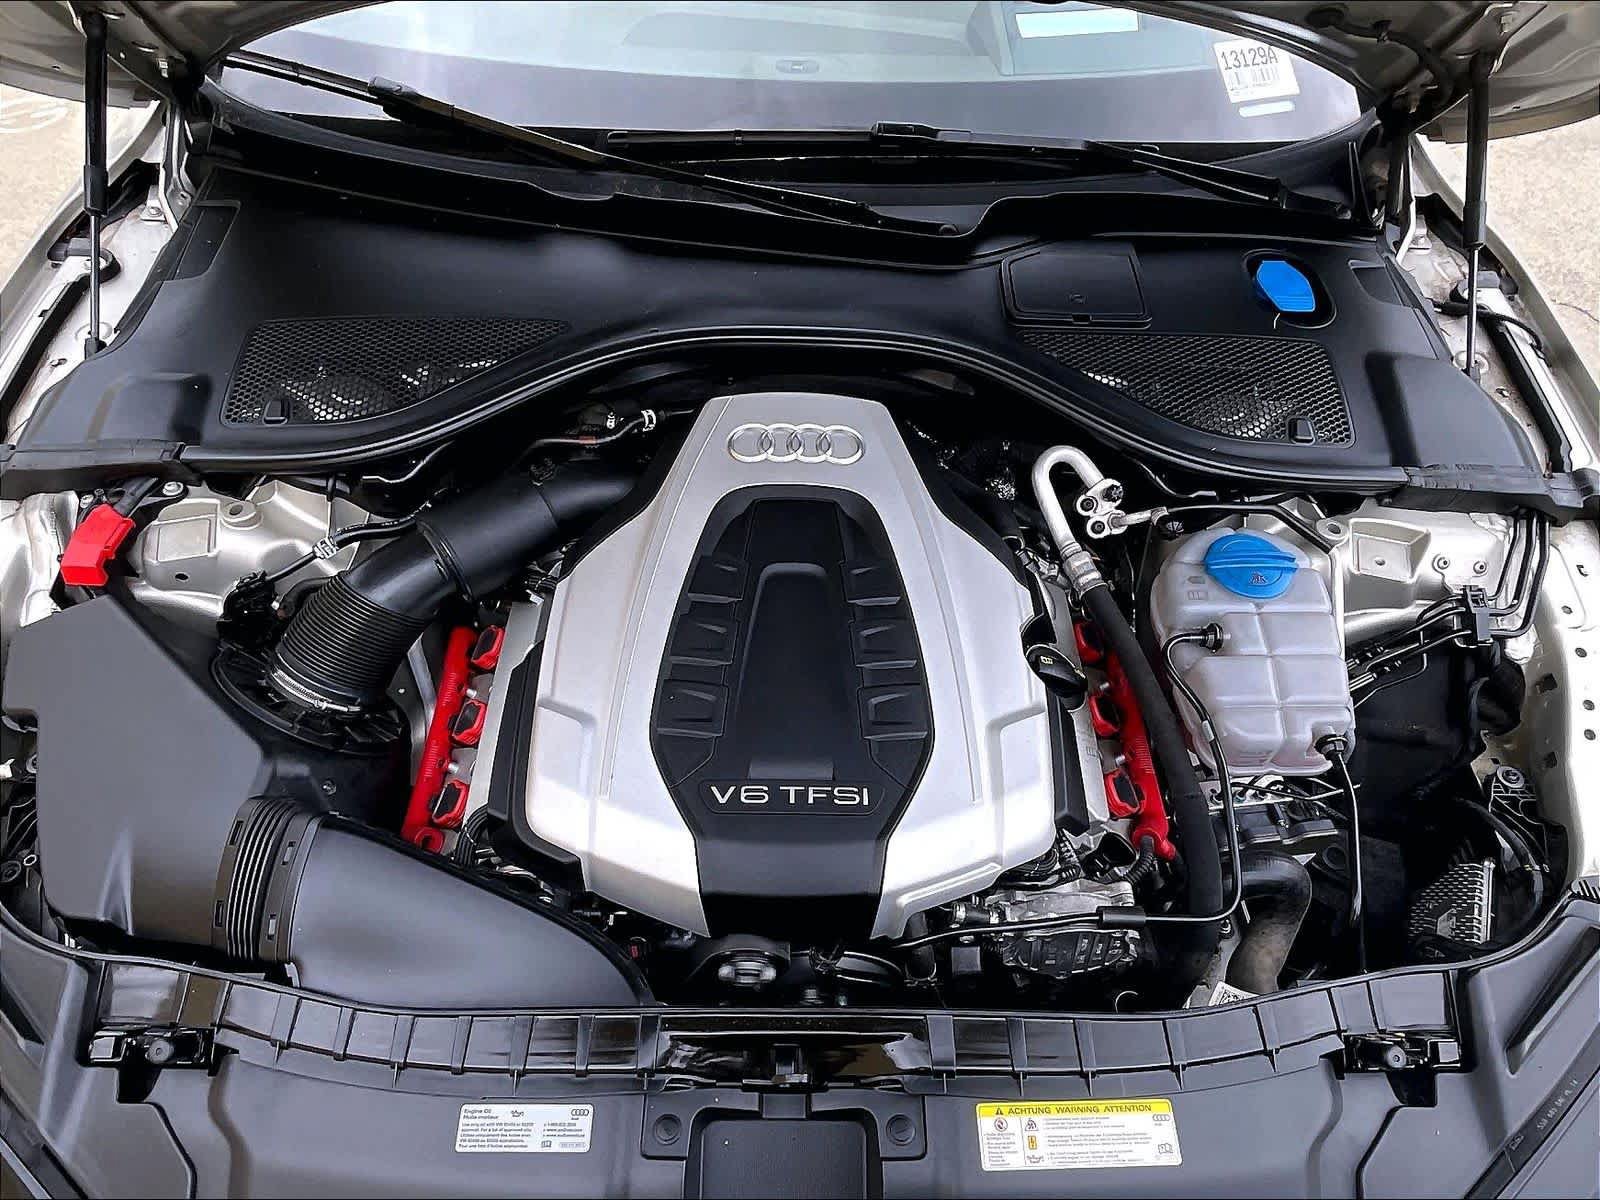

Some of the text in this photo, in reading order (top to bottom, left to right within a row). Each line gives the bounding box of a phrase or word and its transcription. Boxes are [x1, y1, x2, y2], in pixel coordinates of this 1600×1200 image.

[1220, 45, 1279, 71] 13129A
[710, 785, 869, 806] V6 TFSI
[1007, 1104, 1152, 1115] ACHTUNG WARNING ATTENTION
